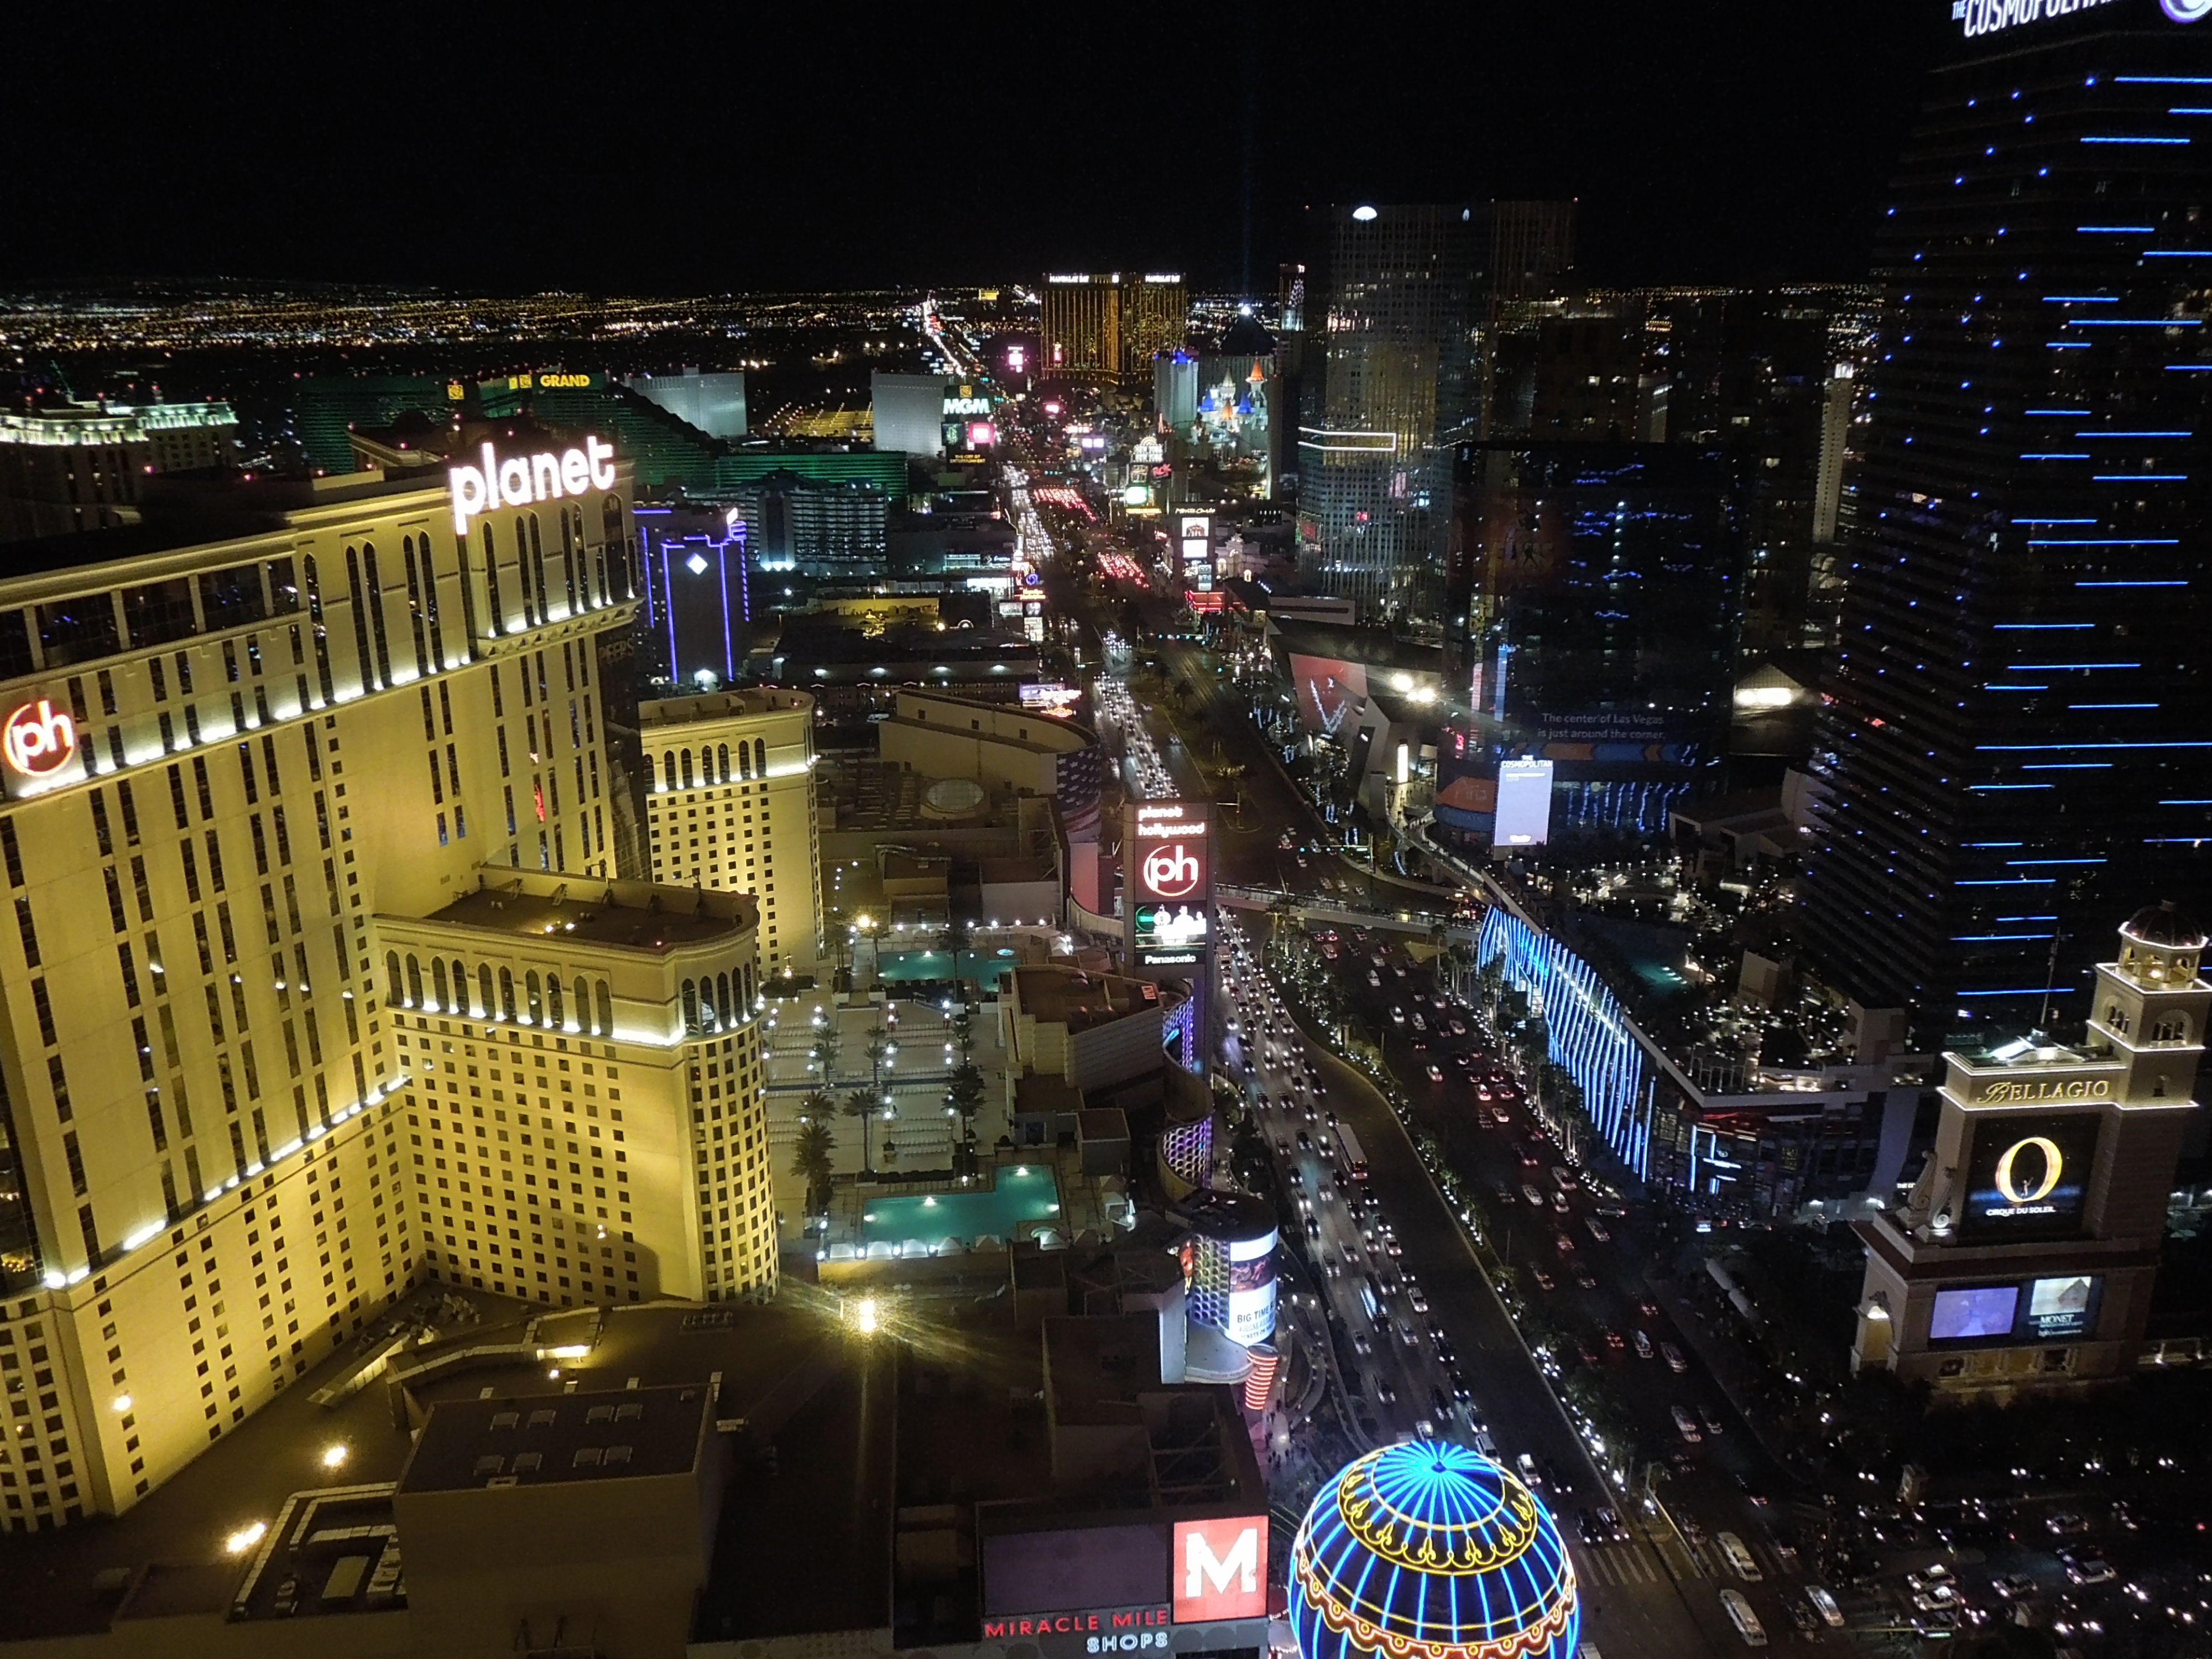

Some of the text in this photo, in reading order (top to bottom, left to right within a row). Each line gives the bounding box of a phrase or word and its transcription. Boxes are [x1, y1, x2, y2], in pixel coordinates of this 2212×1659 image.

[540, 374, 591, 387] GRAND
[942, 398, 991, 415] MGM
[448, 435, 615, 535] planet
[1542, 712, 1665, 726] The center of Las Vegas
[12, 700, 74, 768] ph
[1537, 728, 1546, 737] is
[1548, 728, 1569, 740] just
[1571, 729, 1608, 738] around
[1610, 729, 1626, 738] the
[1138, 805, 1183, 821] planet
[1138, 822, 1205, 838] hollywood
[1150, 845, 1199, 891] ph
[1145, 954, 1196, 964] Panasonic
[1976, 1080, 2109, 1103] BELLAGIO
[1995, 1137, 2063, 1203] O
[1985, 1208, 2015, 1217] CIRQUE
[1237, 1313, 1251, 1323] BIG
[1254, 1305, 1269, 1320] TIME
[2039, 1314, 2074, 1324] MONET
[1185, 1527, 1258, 1599] M
[984, 1609, 1168, 1639] MIRACLE MILE
[1086, 1632, 1169, 1655] SHOPS
